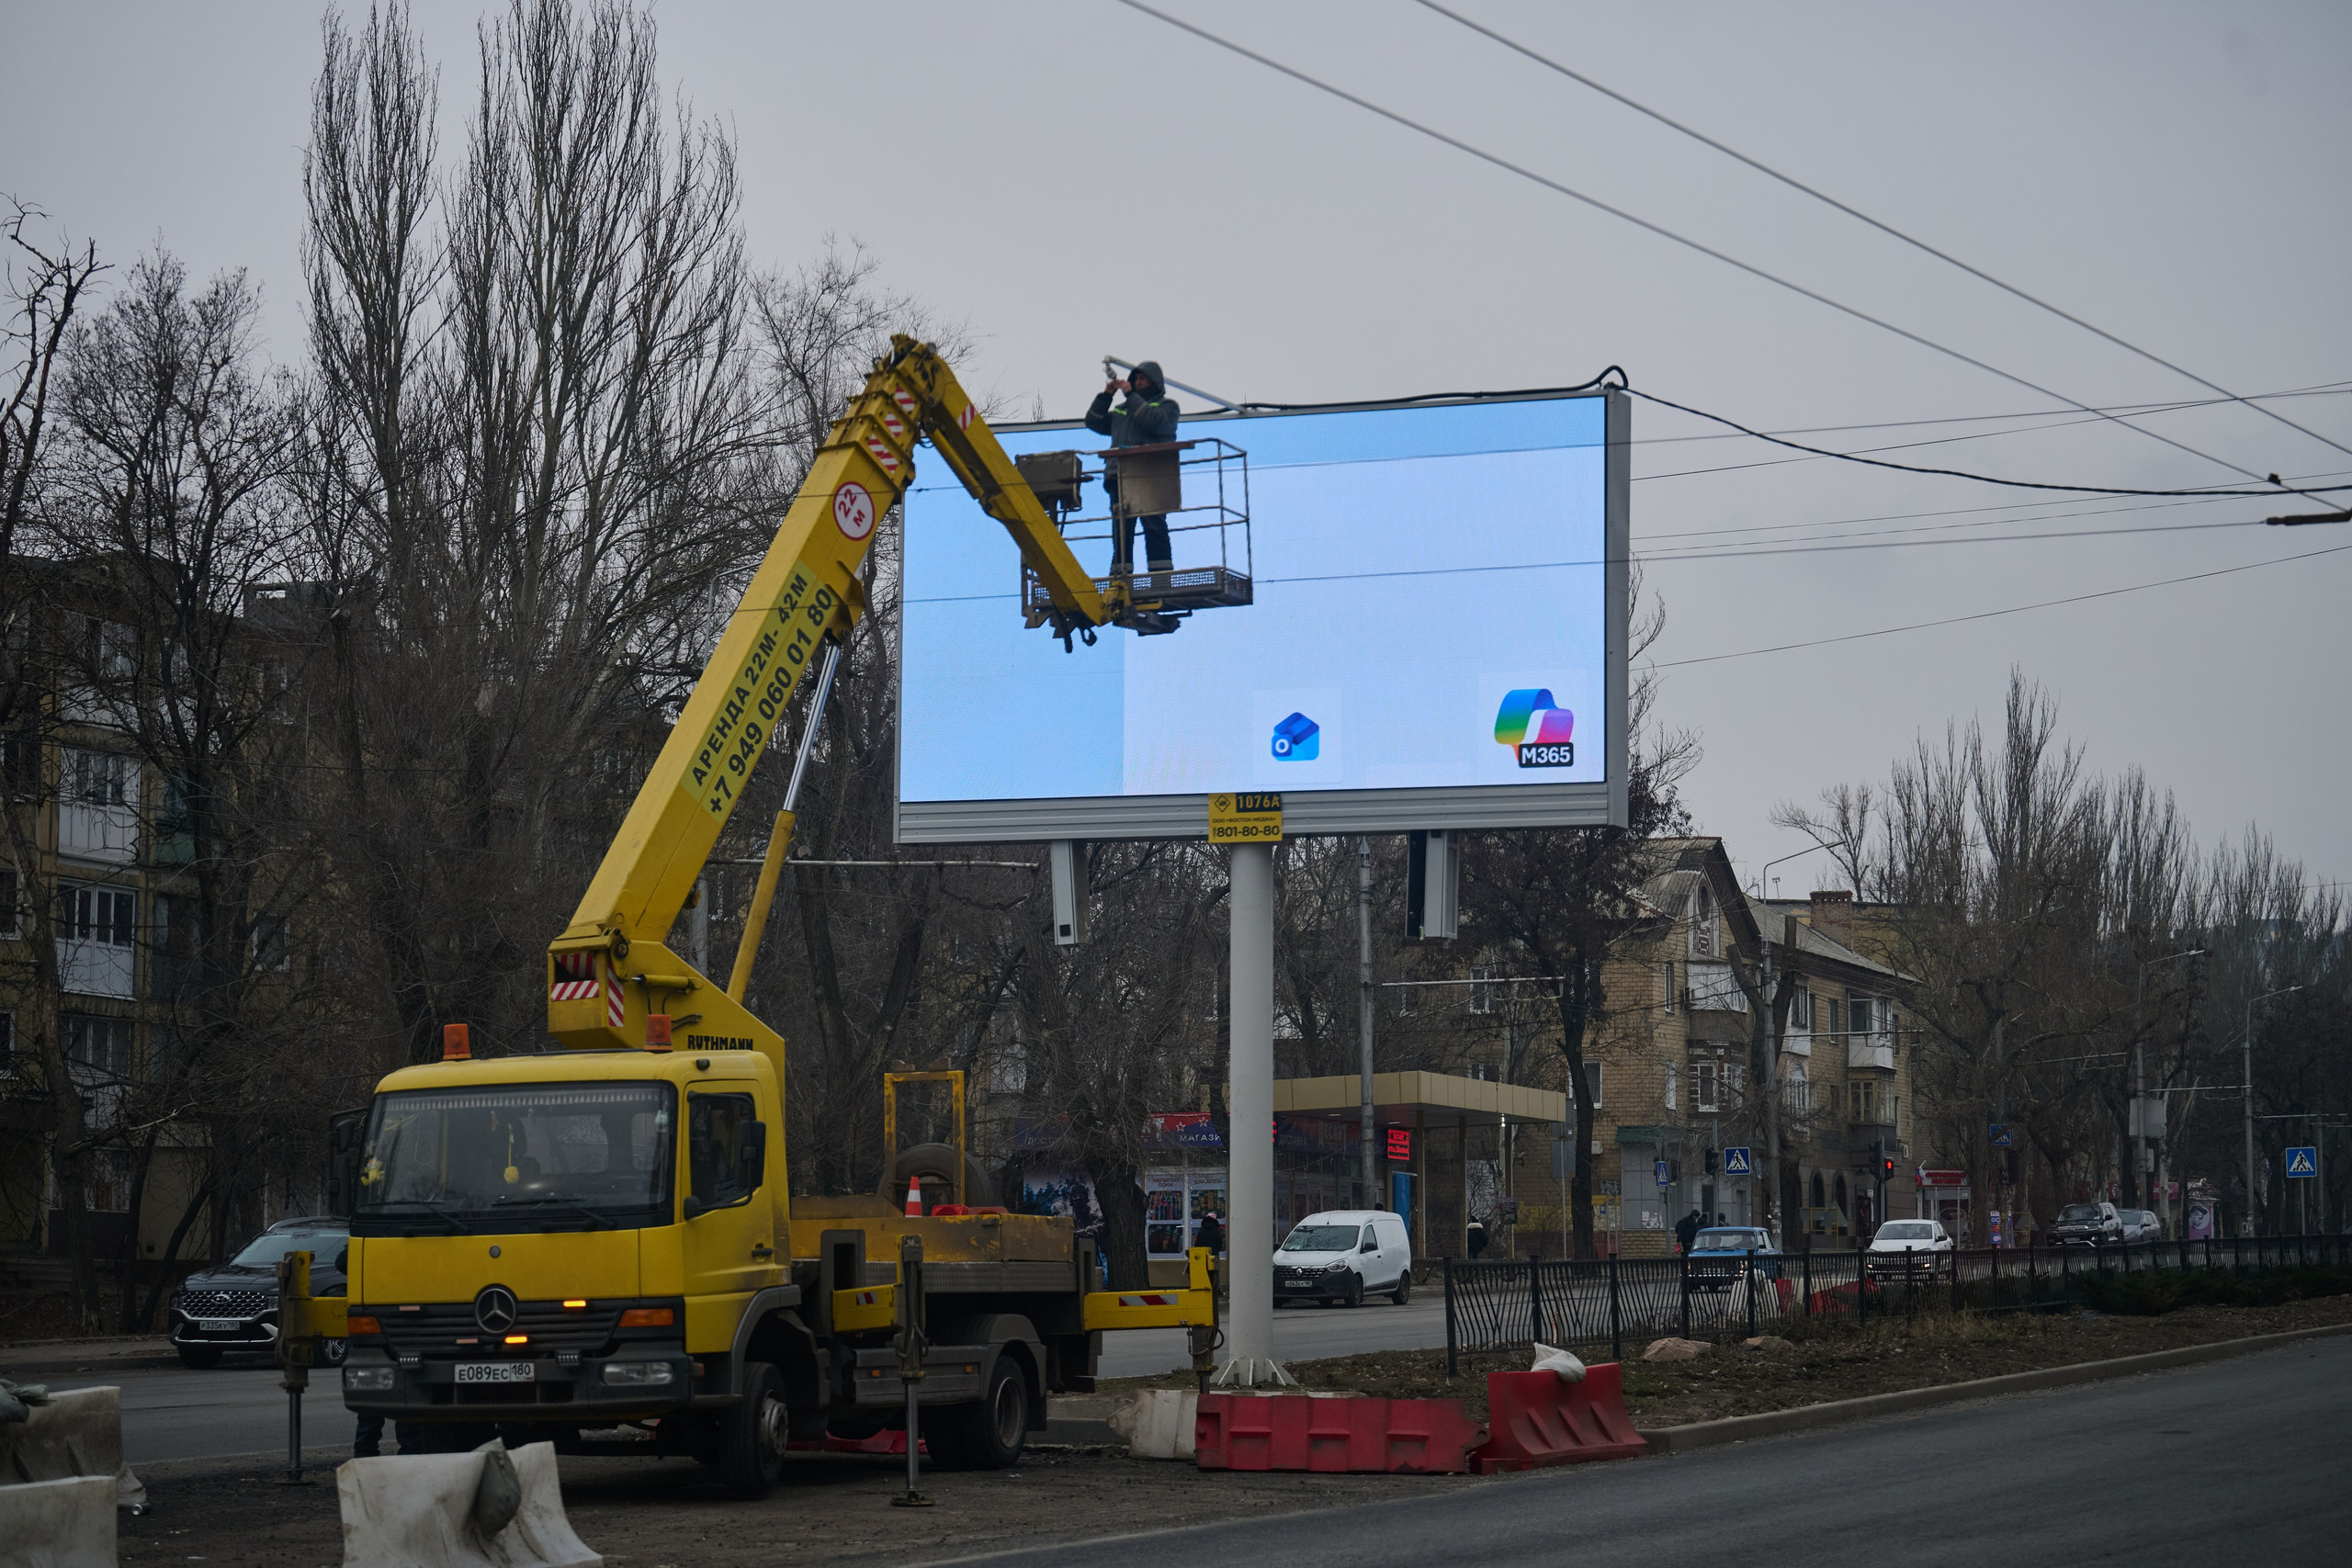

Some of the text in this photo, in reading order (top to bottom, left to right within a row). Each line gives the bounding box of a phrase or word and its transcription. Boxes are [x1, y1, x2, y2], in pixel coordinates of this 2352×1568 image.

[838, 489, 856, 518] 22
[853, 509, 865, 527] М
[691, 685, 750, 787] АРЕНДА
[777, 573, 808, 625] 42М
[710, 588, 832, 813] +7 949 060 01 80
[1521, 746, 1570, 764] M365
[1238, 795, 1280, 808] 1076А
[1217, 825, 1280, 837] 801-80-80
[687, 1034, 753, 1051] RUTHMANN
[1180, 1134, 1221, 1142] МАГАЗИ
[1278, 1134, 1307, 1146] ДОСТАВКА
[511, 1364, 531, 1376] 180
